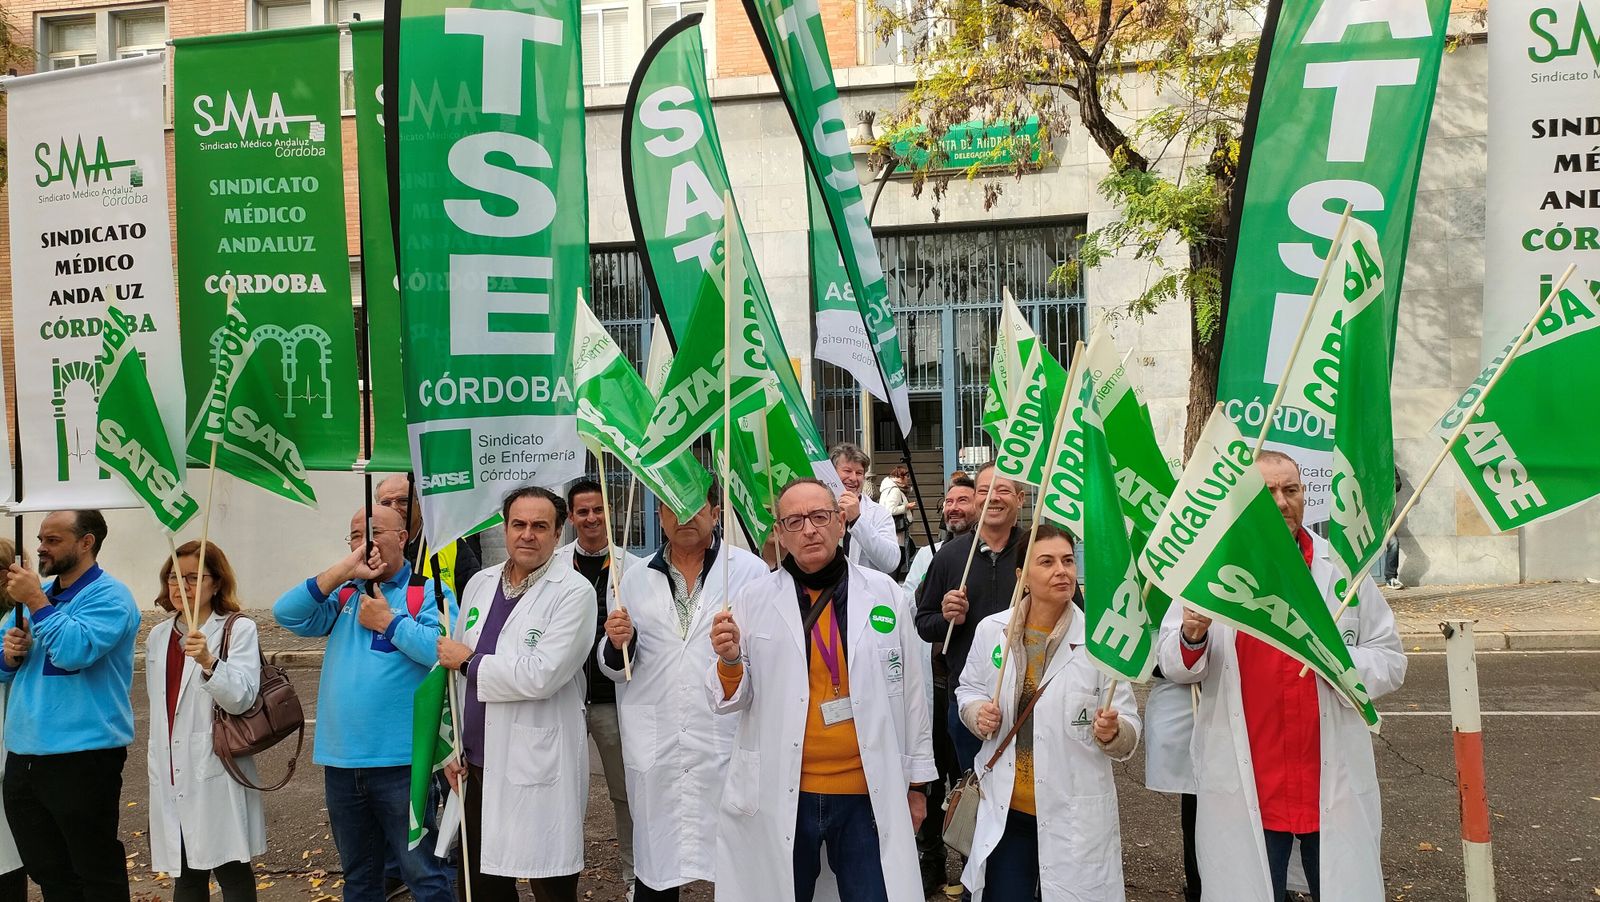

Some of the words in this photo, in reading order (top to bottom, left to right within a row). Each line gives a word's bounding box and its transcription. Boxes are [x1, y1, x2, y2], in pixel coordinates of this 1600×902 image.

[1531, 71, 1588, 83] Sindicato
[193, 88, 317, 140] SMA
[200, 142, 237, 151] Sindicato
[240, 140, 272, 149] Médico
[274, 138, 310, 149] Andaluz
[954, 149, 994, 160] DELEGACI
[35, 133, 136, 189] SMA
[209, 176, 319, 196] SINDICATO
[639, 85, 727, 270] SAT
[38, 194, 71, 204] Sindicato
[73, 189, 100, 199] Médico
[101, 185, 133, 197] Andaluz
[224, 202, 306, 224] MÉDICO
[41, 222, 147, 249] SINDICATO
[217, 236, 316, 254] ANDALUZ
[55, 253, 134, 276] MÉDICO
[204, 270, 327, 295] CÓRDOBA
[49, 283, 144, 306] ANDAUZ
[40, 313, 157, 341] CÓRDBA
[419, 372, 575, 408] CÓRDOBA
[227, 405, 308, 486] SATS
[478, 433, 544, 448] Sindicato
[478, 452, 496, 465] de
[502, 447, 575, 464] Enfermería
[97, 418, 191, 519] SATSE
[420, 469, 471, 491] SATSE
[480, 467, 537, 483] Córdoba
[1144, 438, 1254, 581] Andalucía
[872, 614, 894, 625] SATSE
[1207, 564, 1352, 683] SATS
